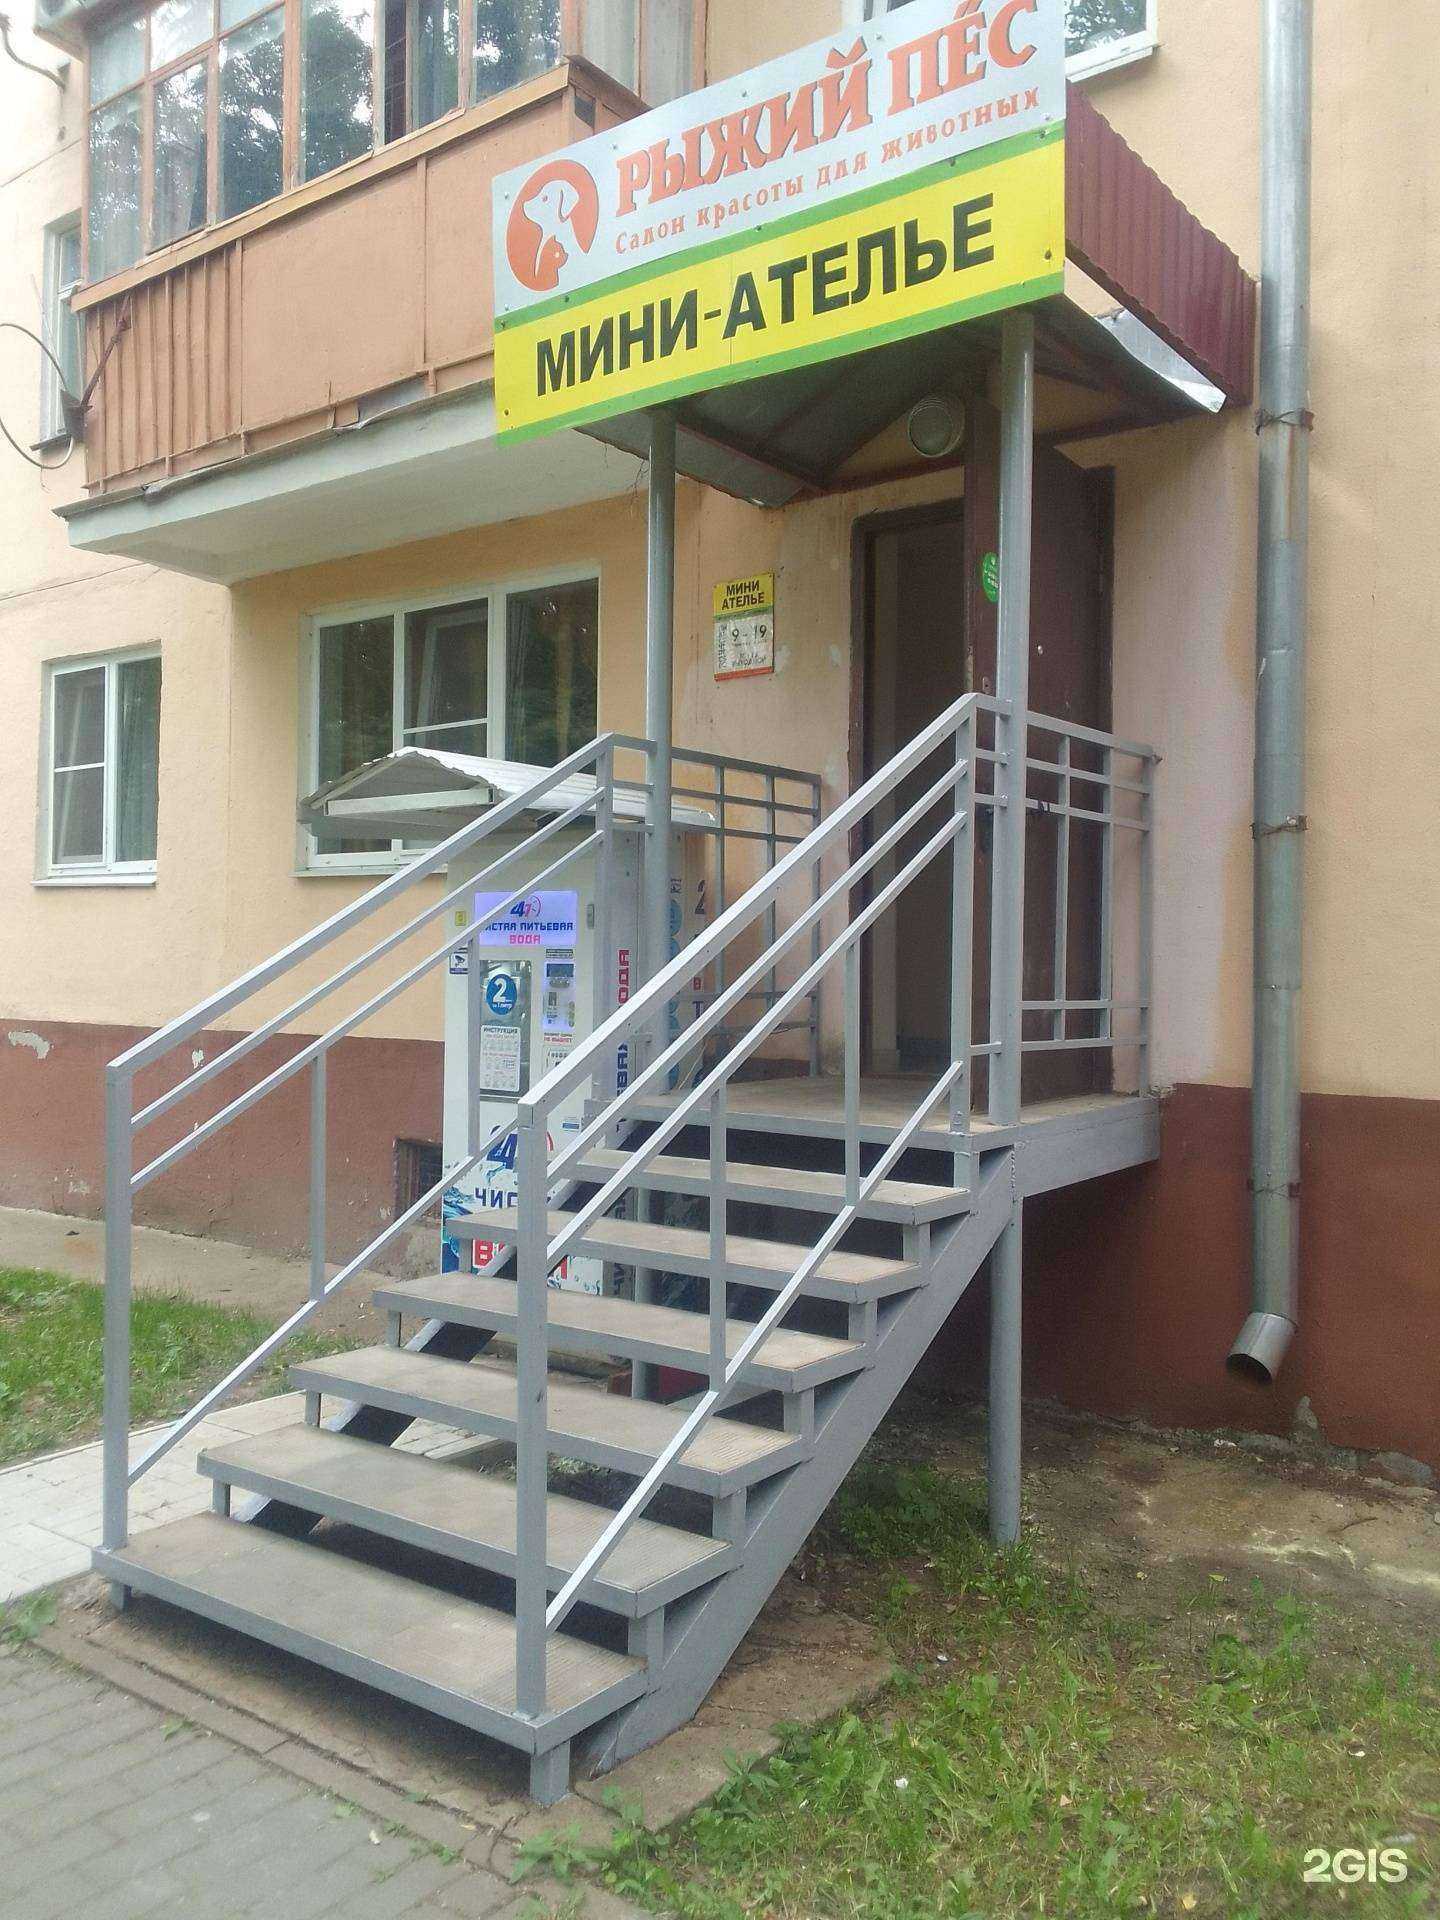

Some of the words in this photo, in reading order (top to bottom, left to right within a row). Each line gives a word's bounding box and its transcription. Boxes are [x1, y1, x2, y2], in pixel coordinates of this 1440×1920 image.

[614, 35, 873, 218] РЫЖИЙ
[886, 0, 1038, 117] ПЁС
[615, 212, 687, 256] Салон
[696, 176, 804, 232] красоты
[816, 142, 868, 188] для
[880, 87, 1040, 165] животных
[535, 192, 995, 397] МИНИ-АТЕЛЬЕ
[726, 580, 760, 597] МИНИ
[721, 591, 765, 610] АТЕЛЬЕ
[484, 922, 517, 931] ИСТАЯ
[520, 922, 573, 931] ПИТЬЕВАЯ
[509, 934, 541, 945] ВОДА
[618, 949, 630, 1006] ОДА
[493, 978, 507, 1003] 2
[474, 1187, 518, 1209] ЧИС
